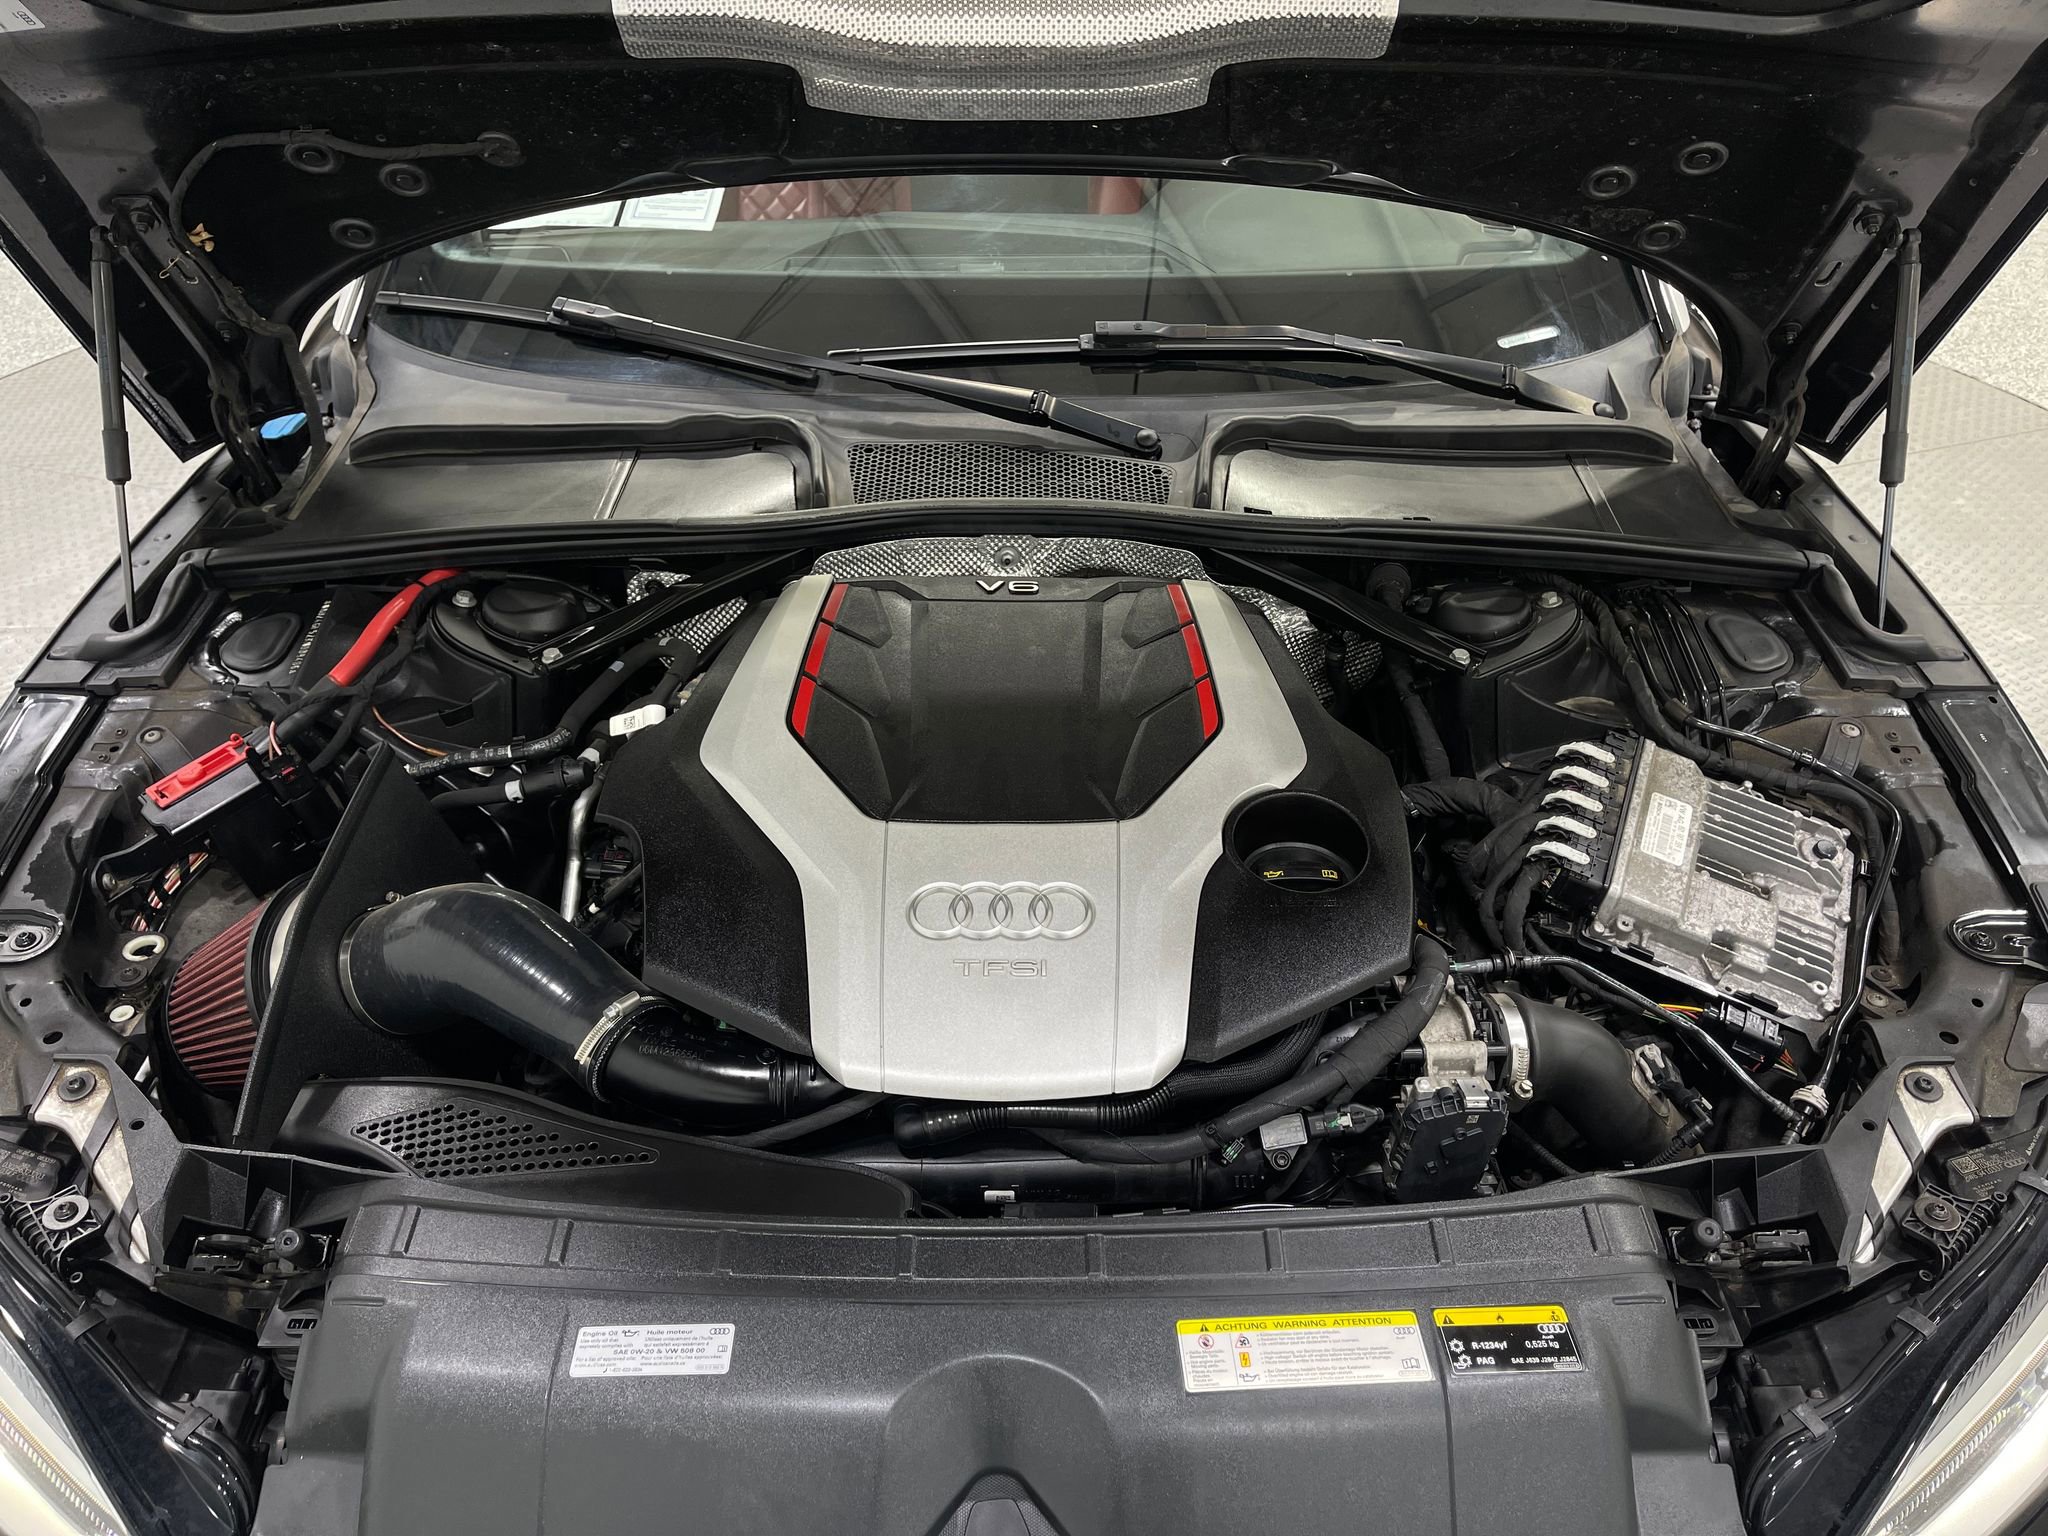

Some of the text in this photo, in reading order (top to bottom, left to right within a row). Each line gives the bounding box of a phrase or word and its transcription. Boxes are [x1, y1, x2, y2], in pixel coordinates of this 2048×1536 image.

[976, 580, 1039, 594] V6
[952, 959, 1048, 977] TFSI
[1214, 1317, 1392, 1331] ACHTUNG WARNING ATTENTION
[1471, 1341, 1508, 1350] R-1234yf
[1548, 1340, 1560, 1349] kg
[1476, 1357, 1496, 1365] PAG
